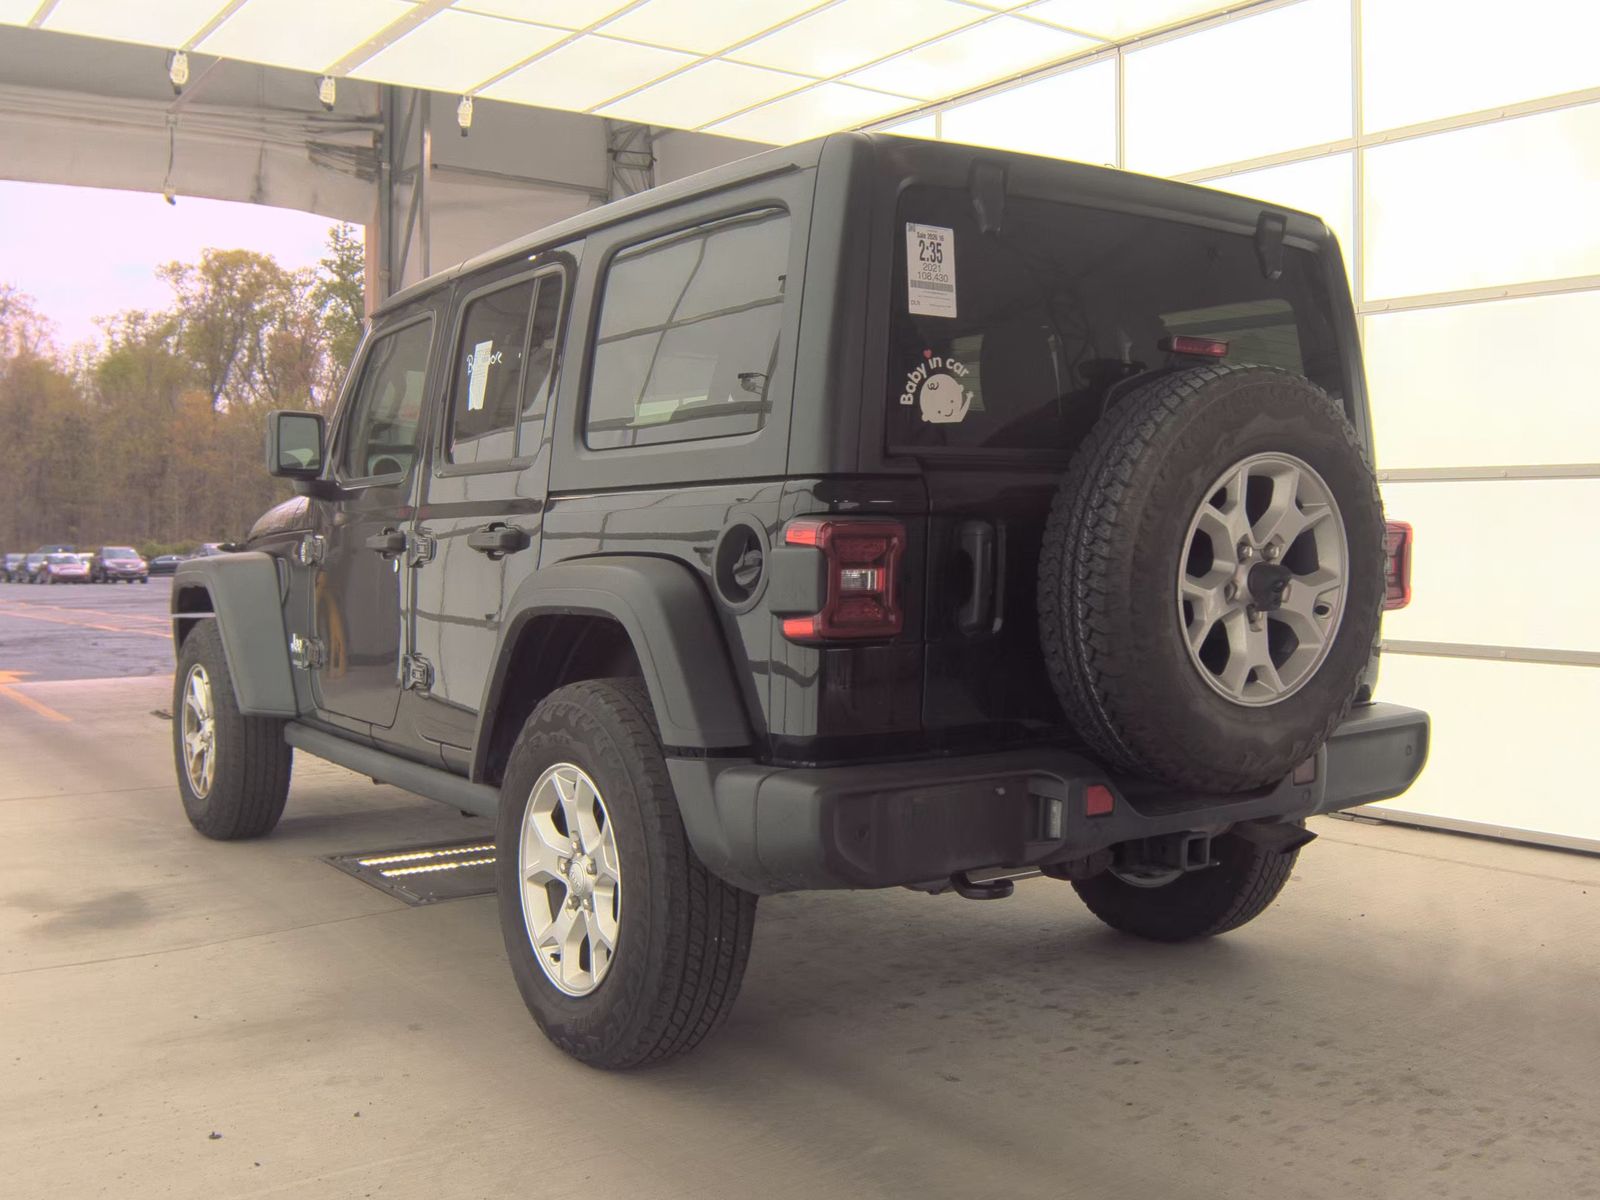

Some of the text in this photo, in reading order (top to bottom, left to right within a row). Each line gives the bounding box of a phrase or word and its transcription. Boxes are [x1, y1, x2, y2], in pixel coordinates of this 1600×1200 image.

[919, 239, 943, 264] 2:35
[922, 263, 941, 272] 2021
[900, 352, 969, 405] Baby in car
